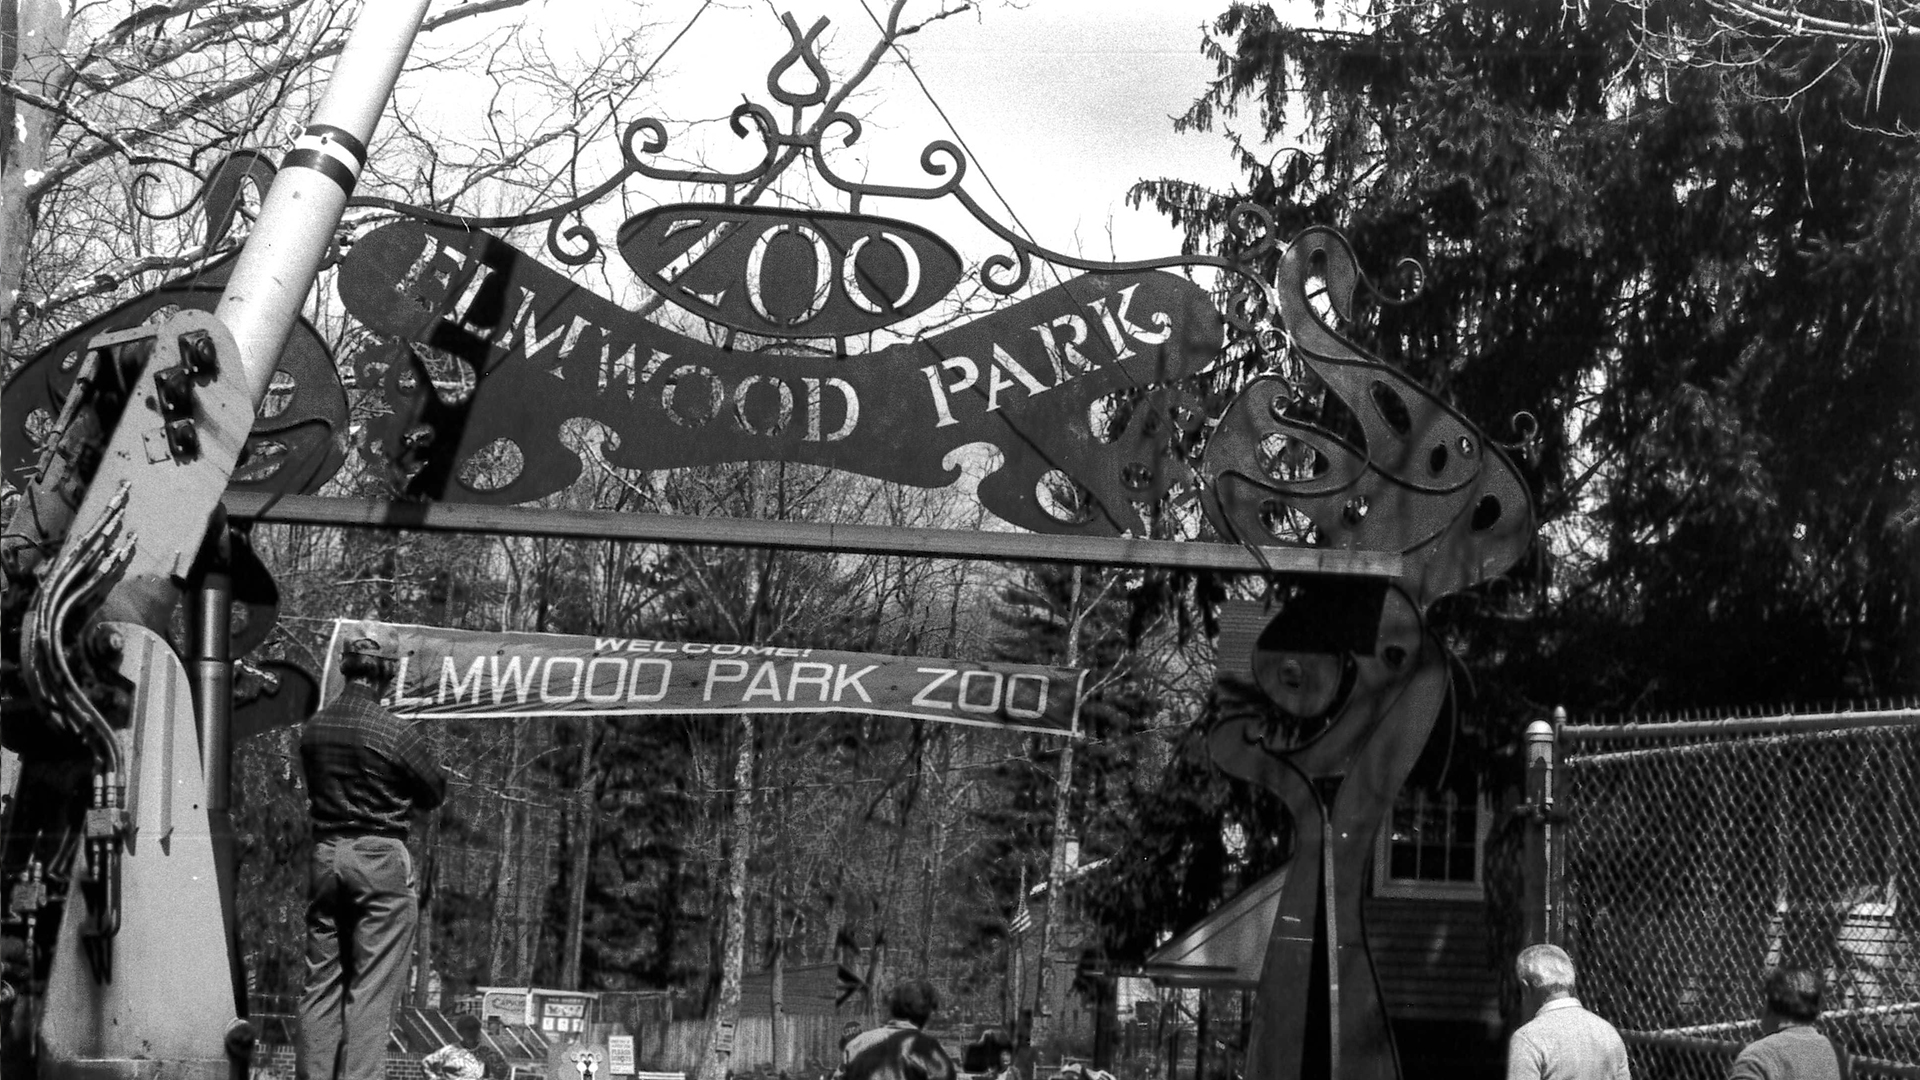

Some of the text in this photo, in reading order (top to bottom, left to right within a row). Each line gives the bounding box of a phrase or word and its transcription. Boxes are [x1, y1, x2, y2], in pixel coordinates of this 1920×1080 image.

[655, 217, 921, 327] ZOO
[396, 232, 1172, 443] ELMWOOD PARK
[380, 655, 1050, 719] LMWOOD PARK ZOO
[593, 637, 813, 658] WELCOME!
